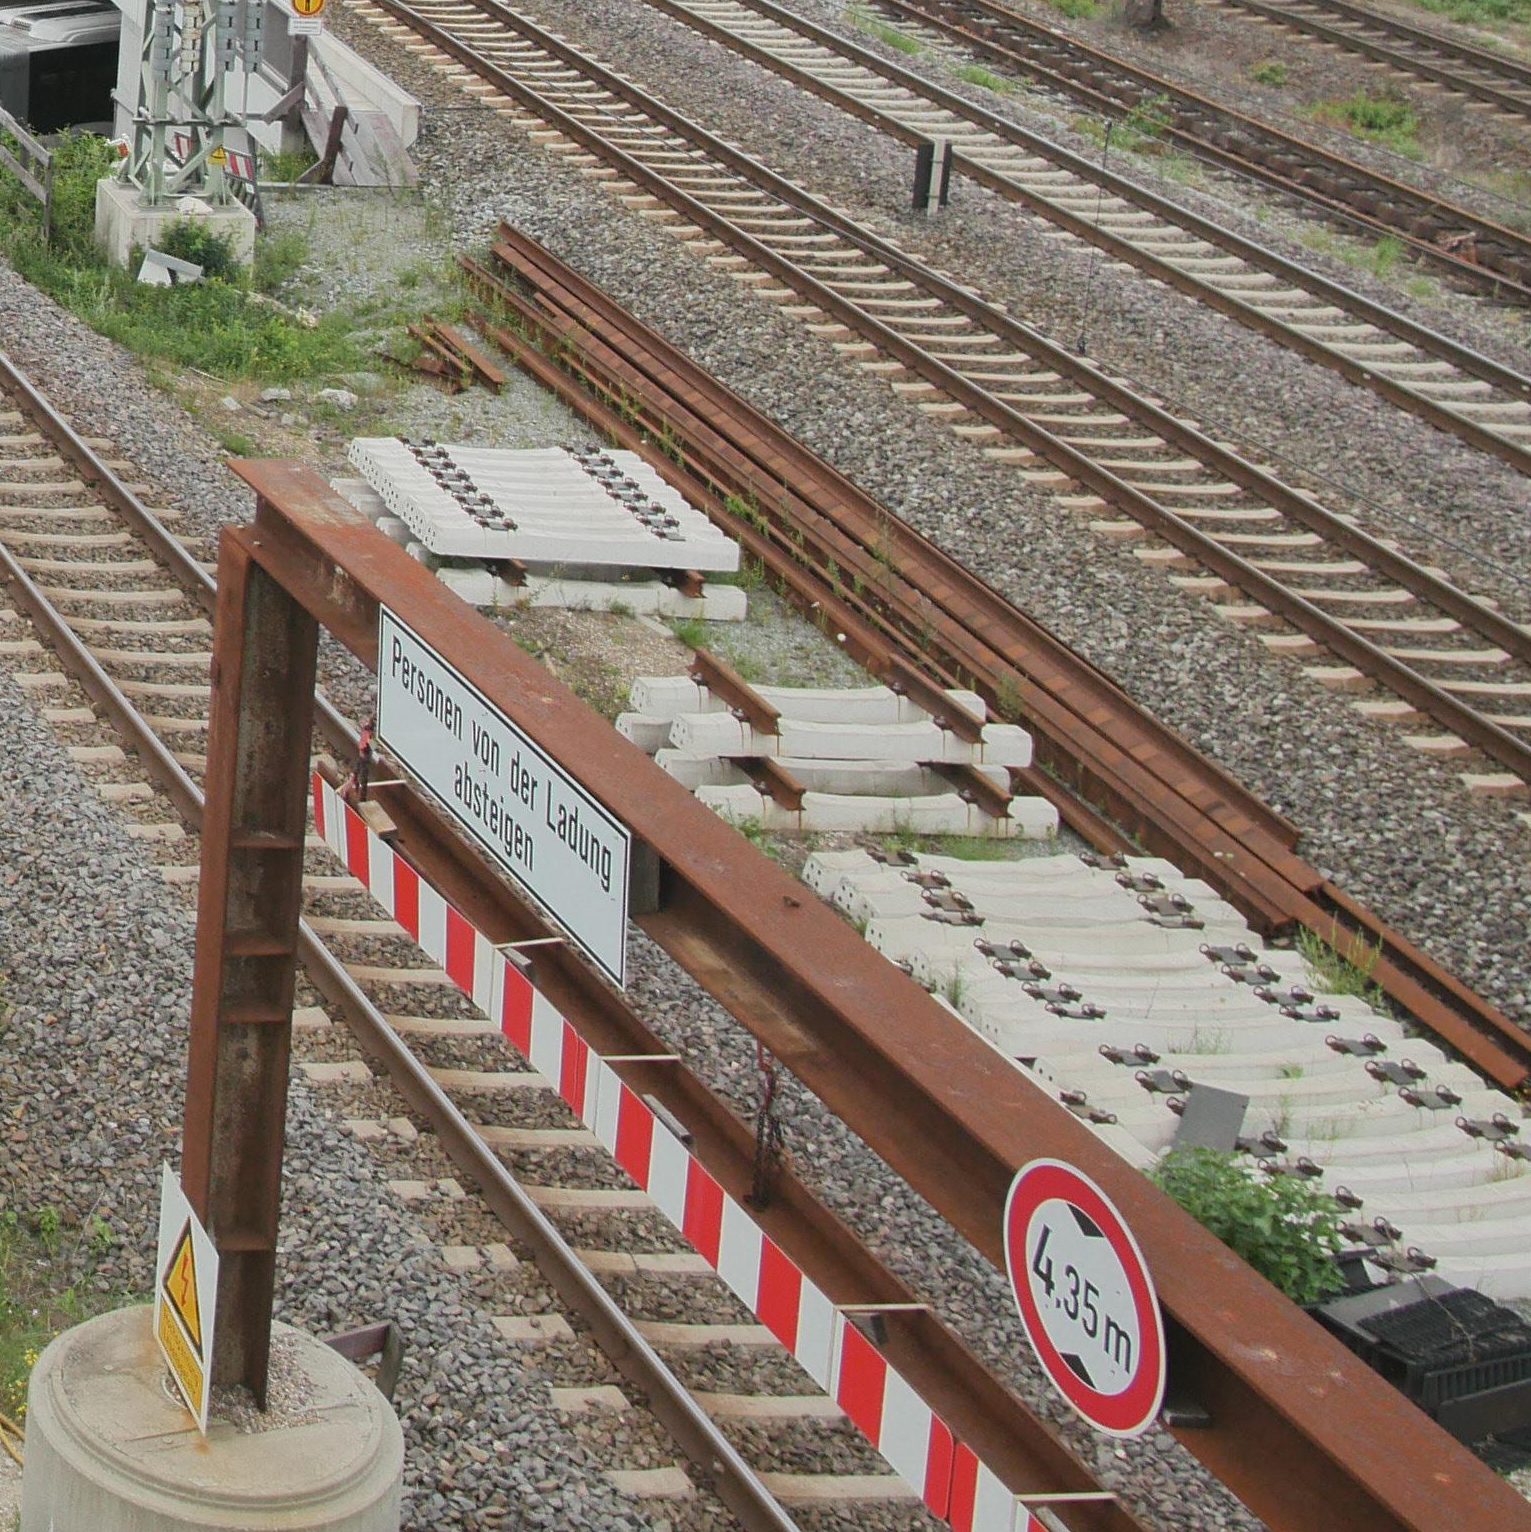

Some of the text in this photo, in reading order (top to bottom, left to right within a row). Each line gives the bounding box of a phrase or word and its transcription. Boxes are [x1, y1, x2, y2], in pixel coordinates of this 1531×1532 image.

[392, 635, 612, 893] Personen von der Ladung
[454, 760, 534, 872] absteigen
